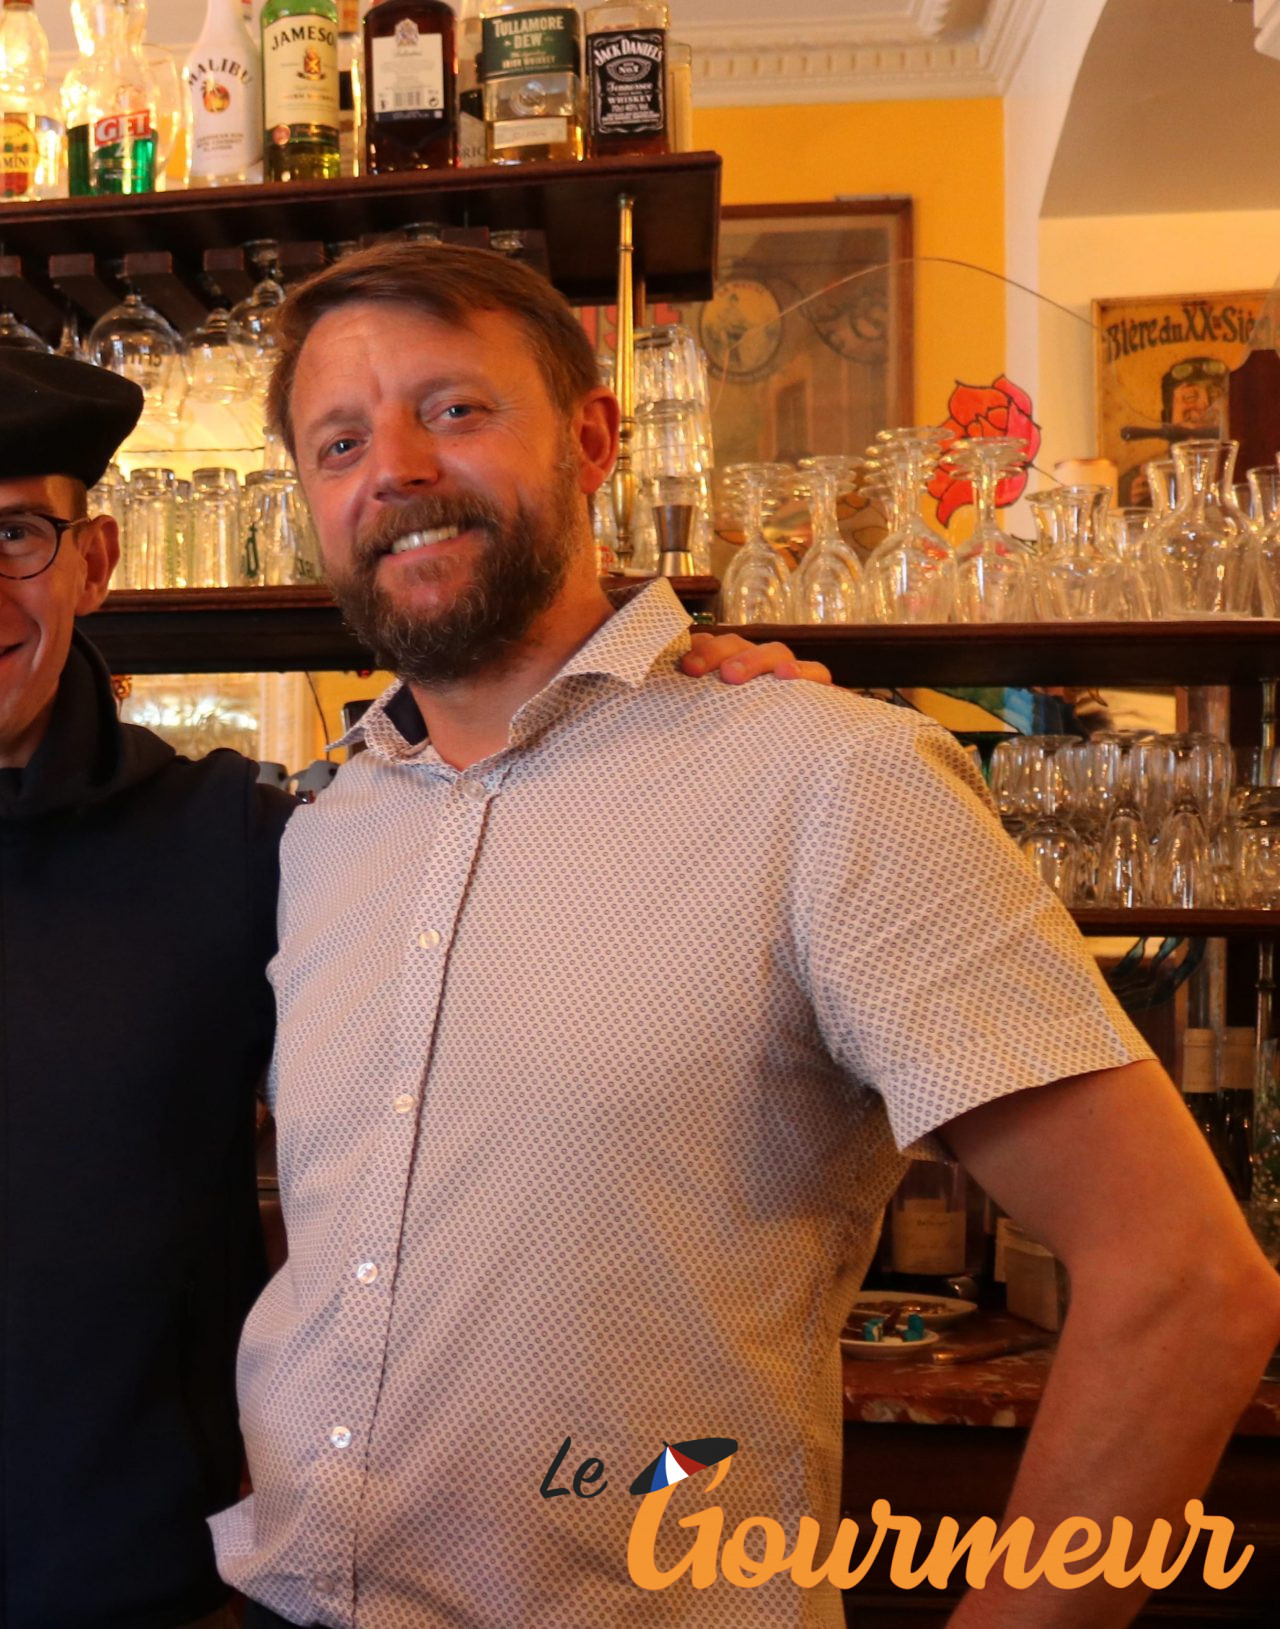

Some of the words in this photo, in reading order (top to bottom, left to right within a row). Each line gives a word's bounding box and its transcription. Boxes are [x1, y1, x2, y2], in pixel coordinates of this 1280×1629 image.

[272, 26, 335, 51] JAMESO
[492, 16, 566, 38] TULLAMORE
[513, 33, 543, 49] DEW
[593, 43, 622, 66] JACK
[96, 113, 148, 142] GET
[1102, 318, 1158, 364] Bière
[1159, 316, 1184, 345] du
